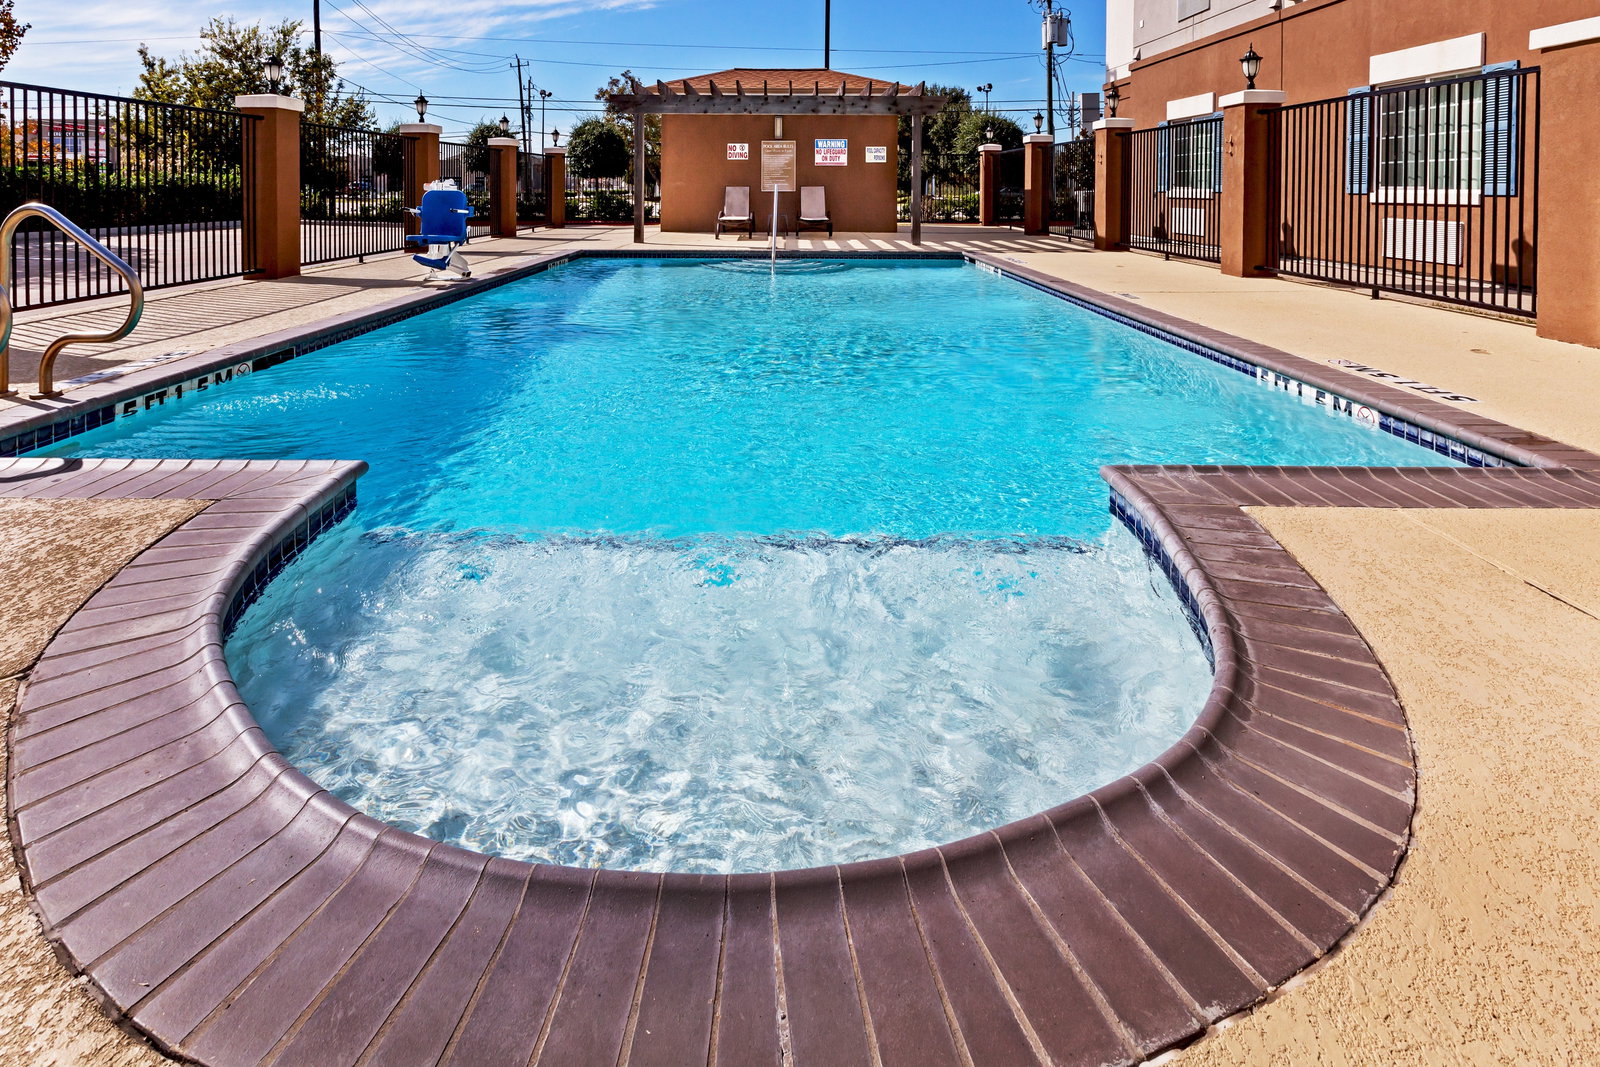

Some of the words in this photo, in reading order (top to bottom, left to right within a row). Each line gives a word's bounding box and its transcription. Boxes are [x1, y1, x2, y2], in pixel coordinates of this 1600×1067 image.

[728, 144, 737, 152] NO
[817, 140, 845, 148] WARNING
[728, 151, 748, 159] DIVING
